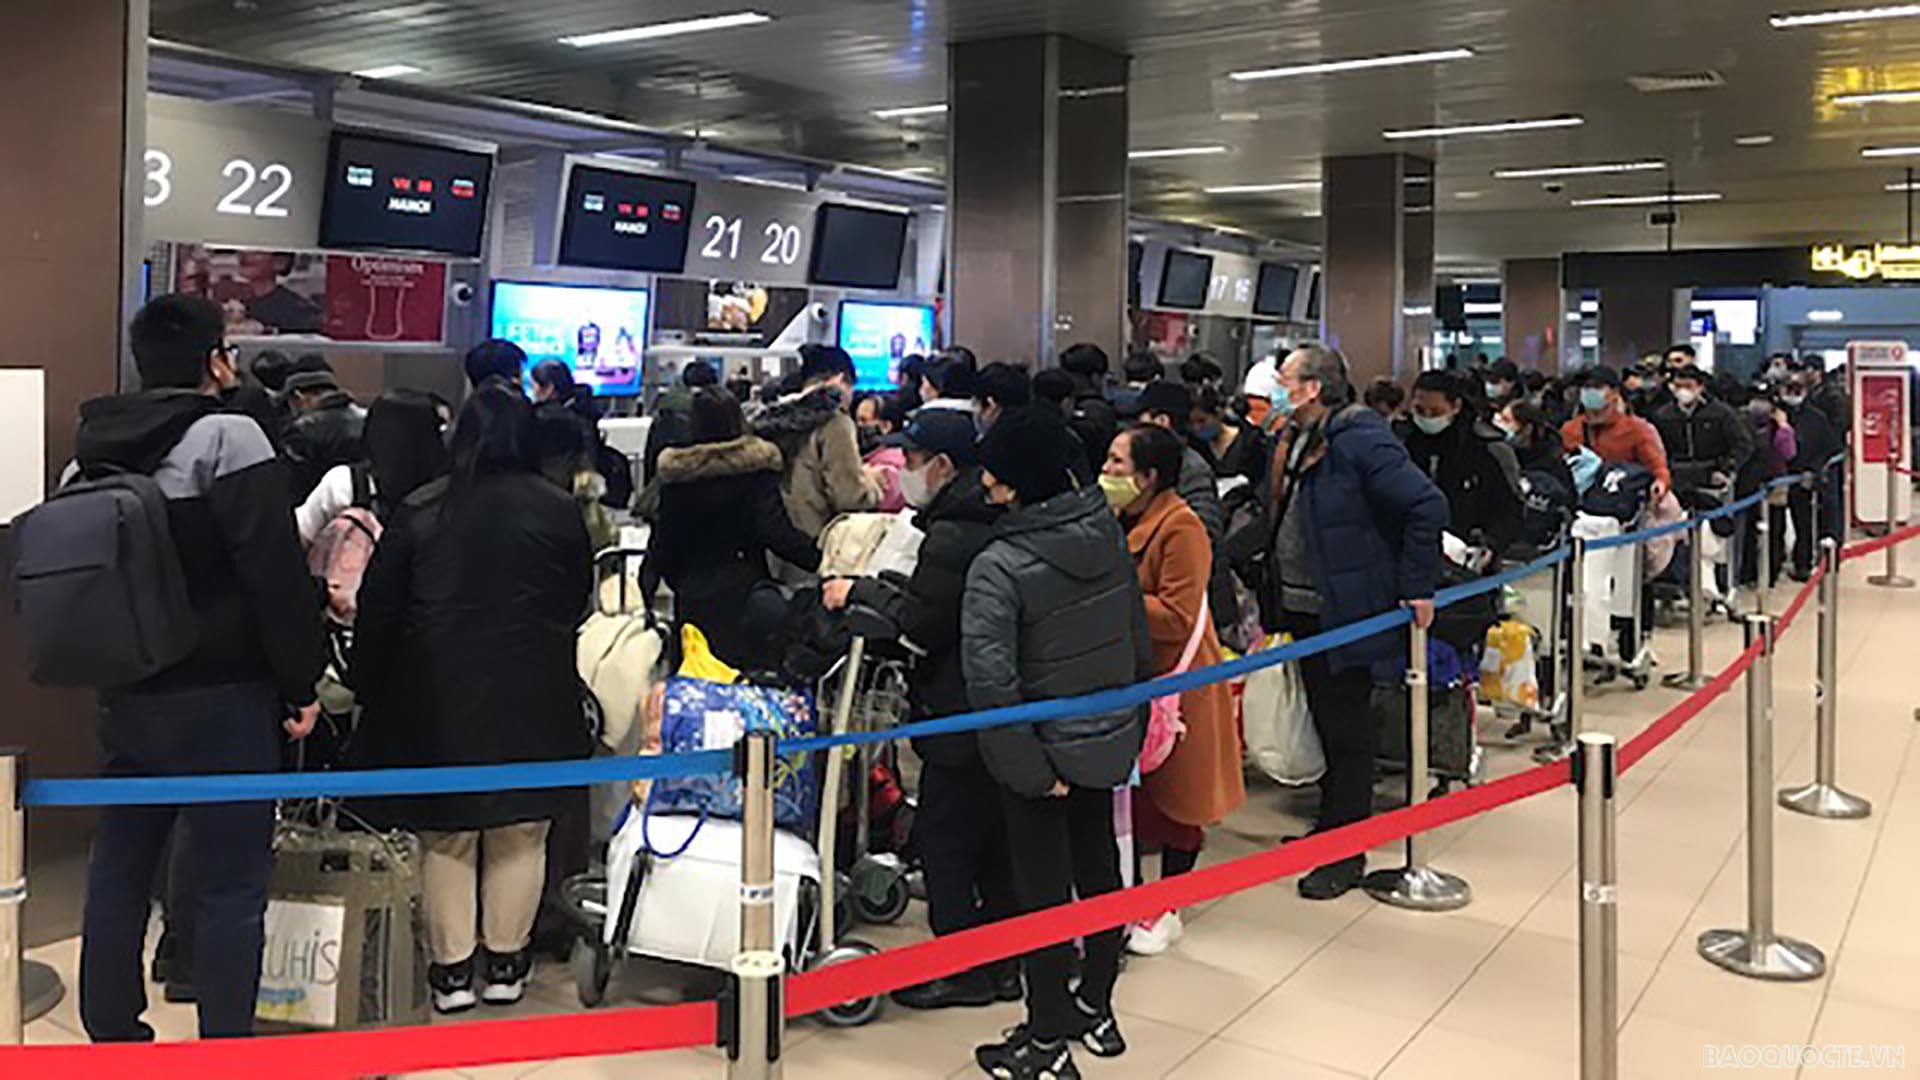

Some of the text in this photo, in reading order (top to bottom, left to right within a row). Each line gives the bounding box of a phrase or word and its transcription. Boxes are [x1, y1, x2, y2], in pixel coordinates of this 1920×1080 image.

[216, 159, 292, 217] 22
[702, 215, 801, 265] 21 20
